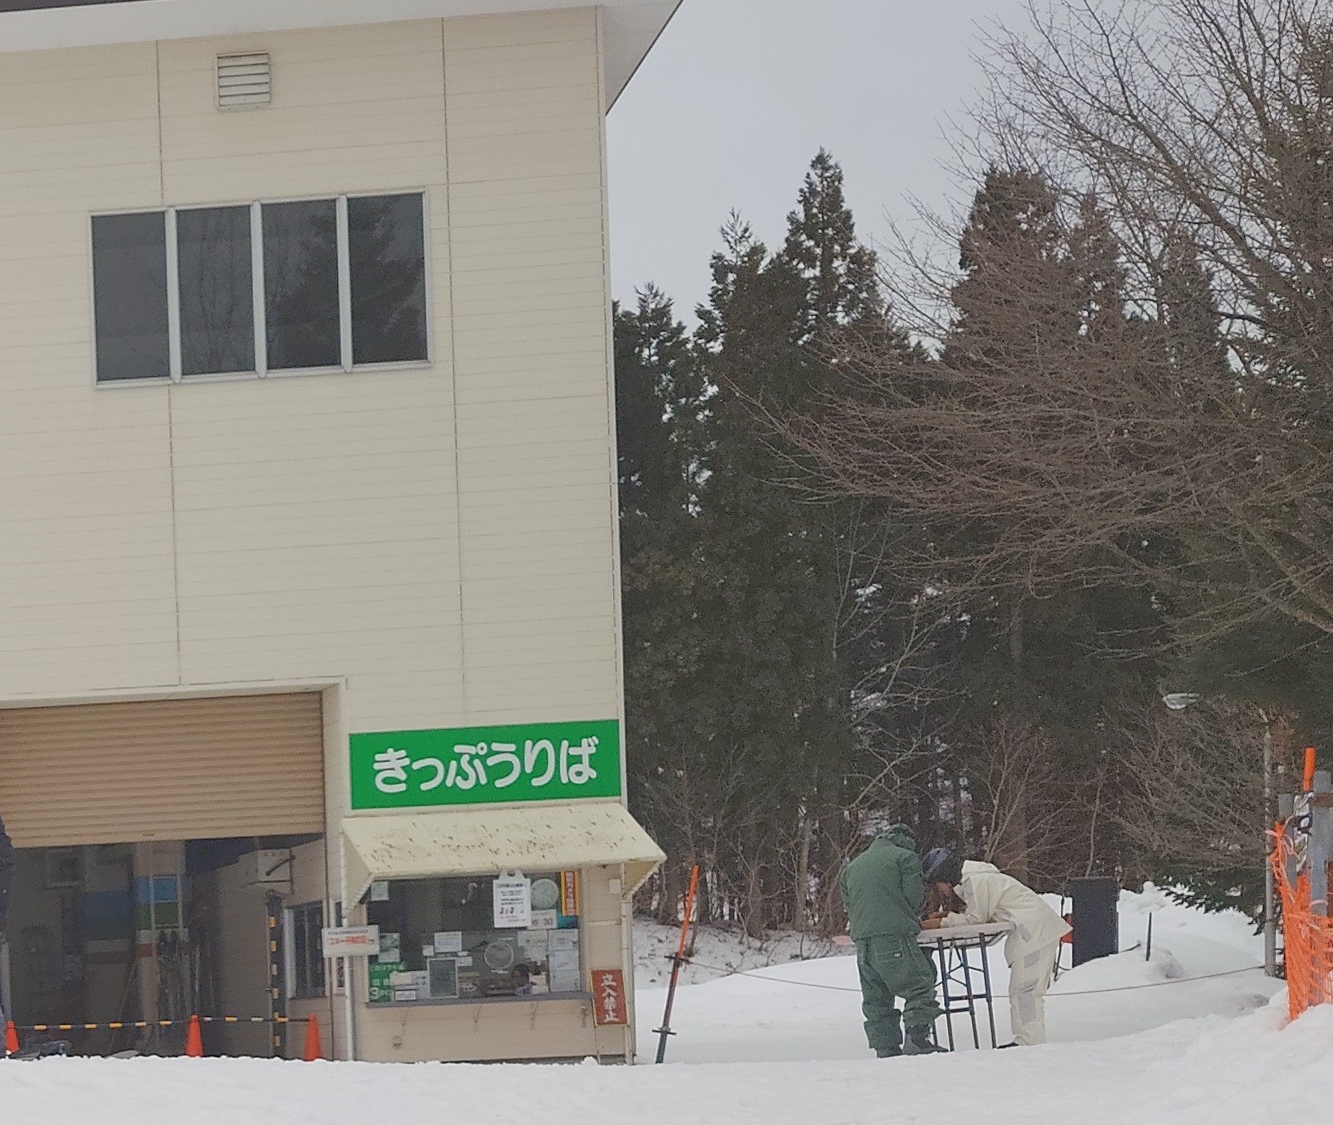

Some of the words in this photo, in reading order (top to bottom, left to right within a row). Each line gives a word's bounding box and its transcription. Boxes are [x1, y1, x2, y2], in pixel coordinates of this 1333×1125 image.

[372, 736, 600, 794] きっぷうりば
